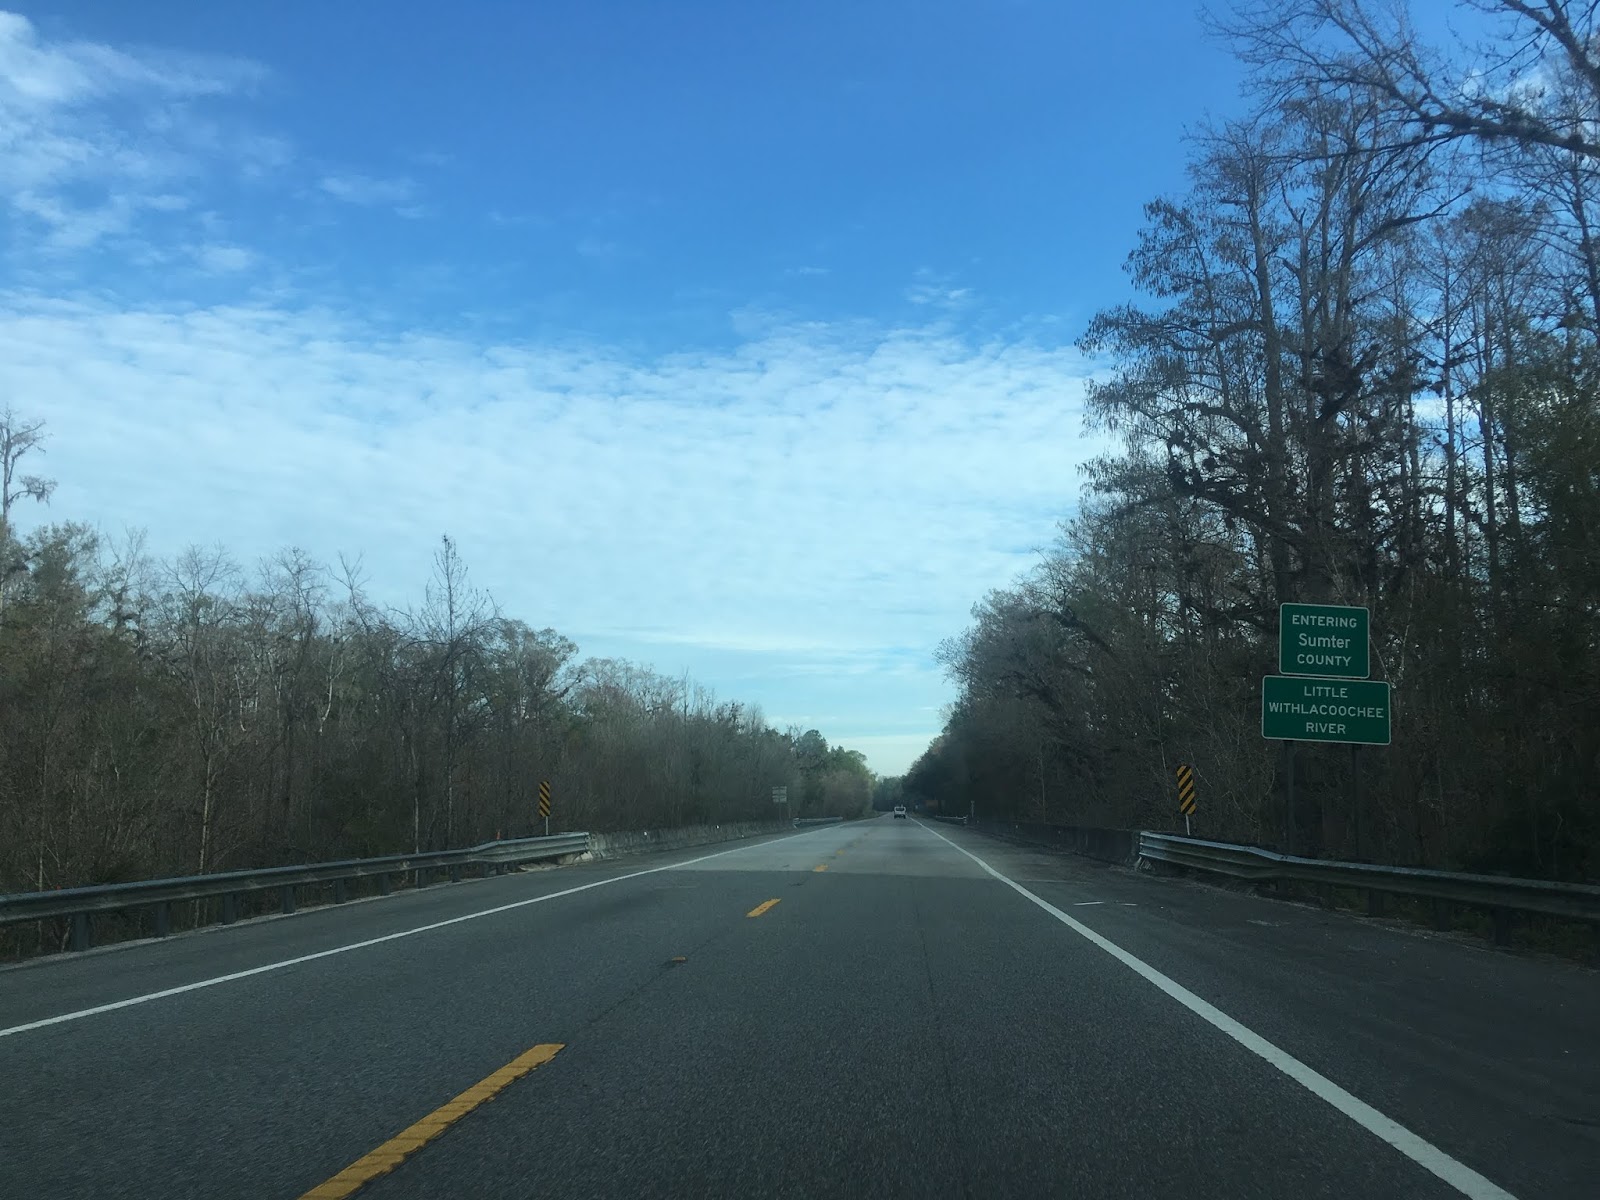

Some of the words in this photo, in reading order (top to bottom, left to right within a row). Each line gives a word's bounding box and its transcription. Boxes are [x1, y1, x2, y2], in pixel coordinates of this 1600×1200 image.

[1292, 615, 1357, 628] ENTERING
[1298, 633, 1351, 649] Sumter
[1297, 654, 1352, 667] COUNTY
[1304, 686, 1348, 698] LITTLE
[1268, 702, 1384, 718] WITHLACOOCHEE
[1306, 722, 1346, 734] RIVER
